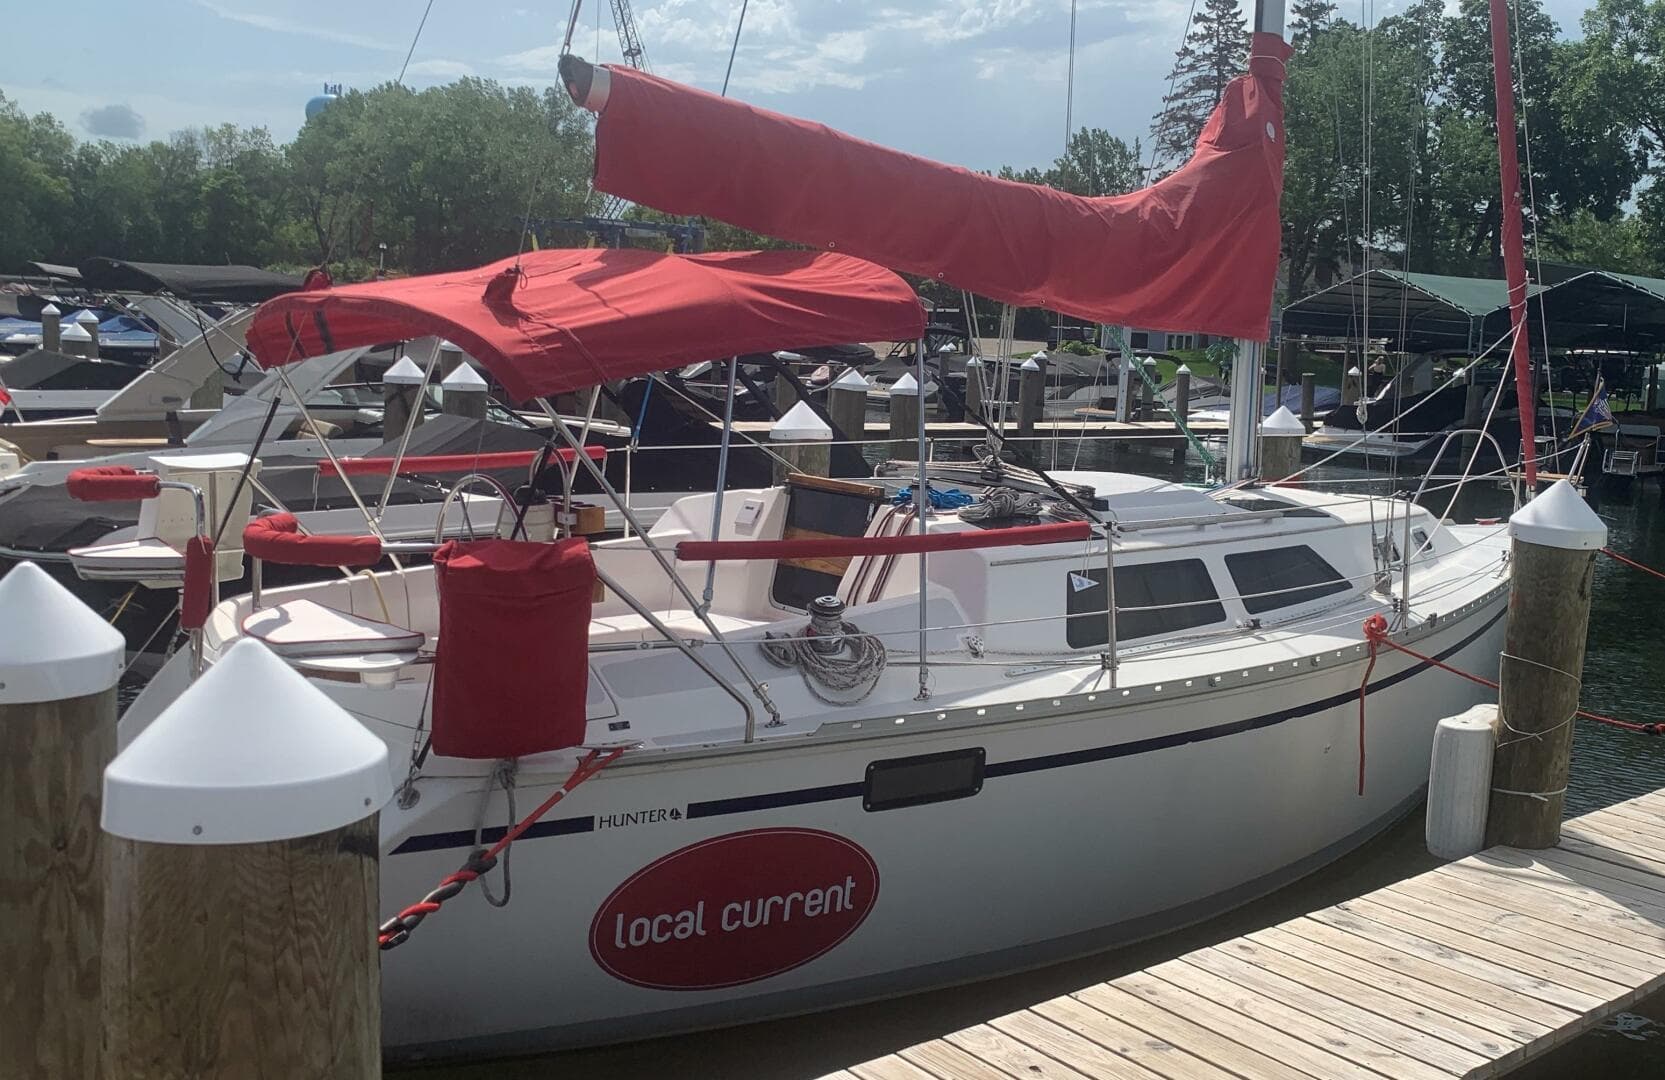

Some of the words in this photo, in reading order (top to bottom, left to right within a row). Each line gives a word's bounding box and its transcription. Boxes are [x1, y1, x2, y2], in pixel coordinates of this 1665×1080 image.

[600, 809, 667, 829] HUNTER
[615, 900, 706, 949] local
[721, 875, 856, 932] current
